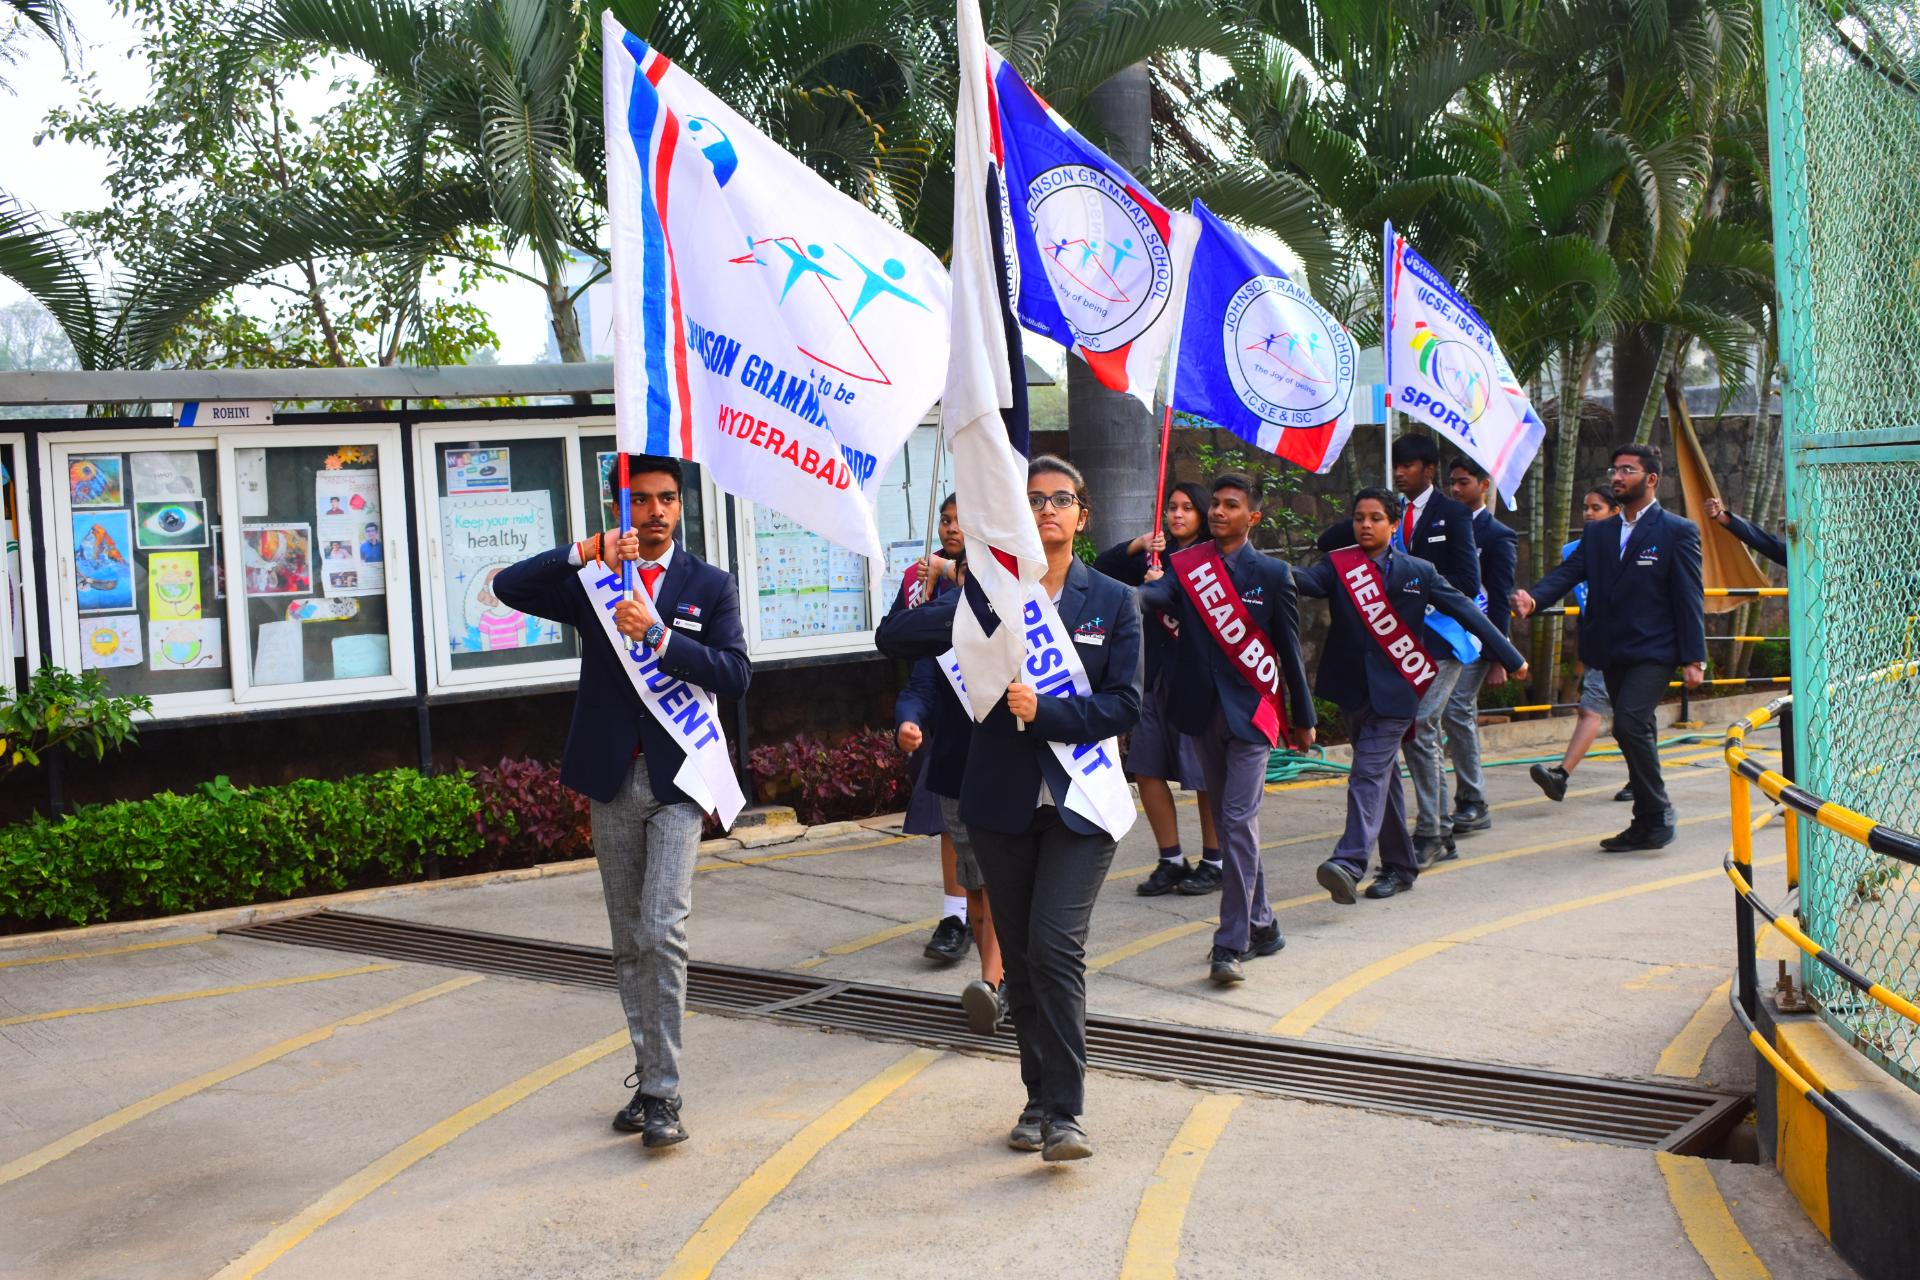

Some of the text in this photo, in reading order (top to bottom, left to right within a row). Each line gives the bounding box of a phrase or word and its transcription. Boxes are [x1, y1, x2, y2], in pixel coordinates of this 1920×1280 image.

[1078, 168, 1150, 231] GRAMMAR
[1146, 233, 1170, 300] SCHOOL
[1072, 292, 1083, 303] of
[1083, 298, 1109, 318] being
[1454, 313, 1475, 336] ISC
[1475, 333, 1485, 346] &
[1330, 323, 1351, 384] SCHOOL
[1254, 363, 1269, 375] The
[1270, 370, 1284, 382] Joy
[817, 374, 856, 405] to be
[212, 407, 250, 419] ROHINI
[1279, 410, 1289, 422] &
[1292, 412, 1313, 424] ISC
[718, 403, 851, 490] HYDERABAD
[454, 508, 536, 532] Keep your mind
[467, 529, 528, 552] healthy
[1187, 561, 1247, 645] HEAD
[1345, 563, 1436, 686] HEAD BOY
[594, 572, 720, 751] PSIDENT
